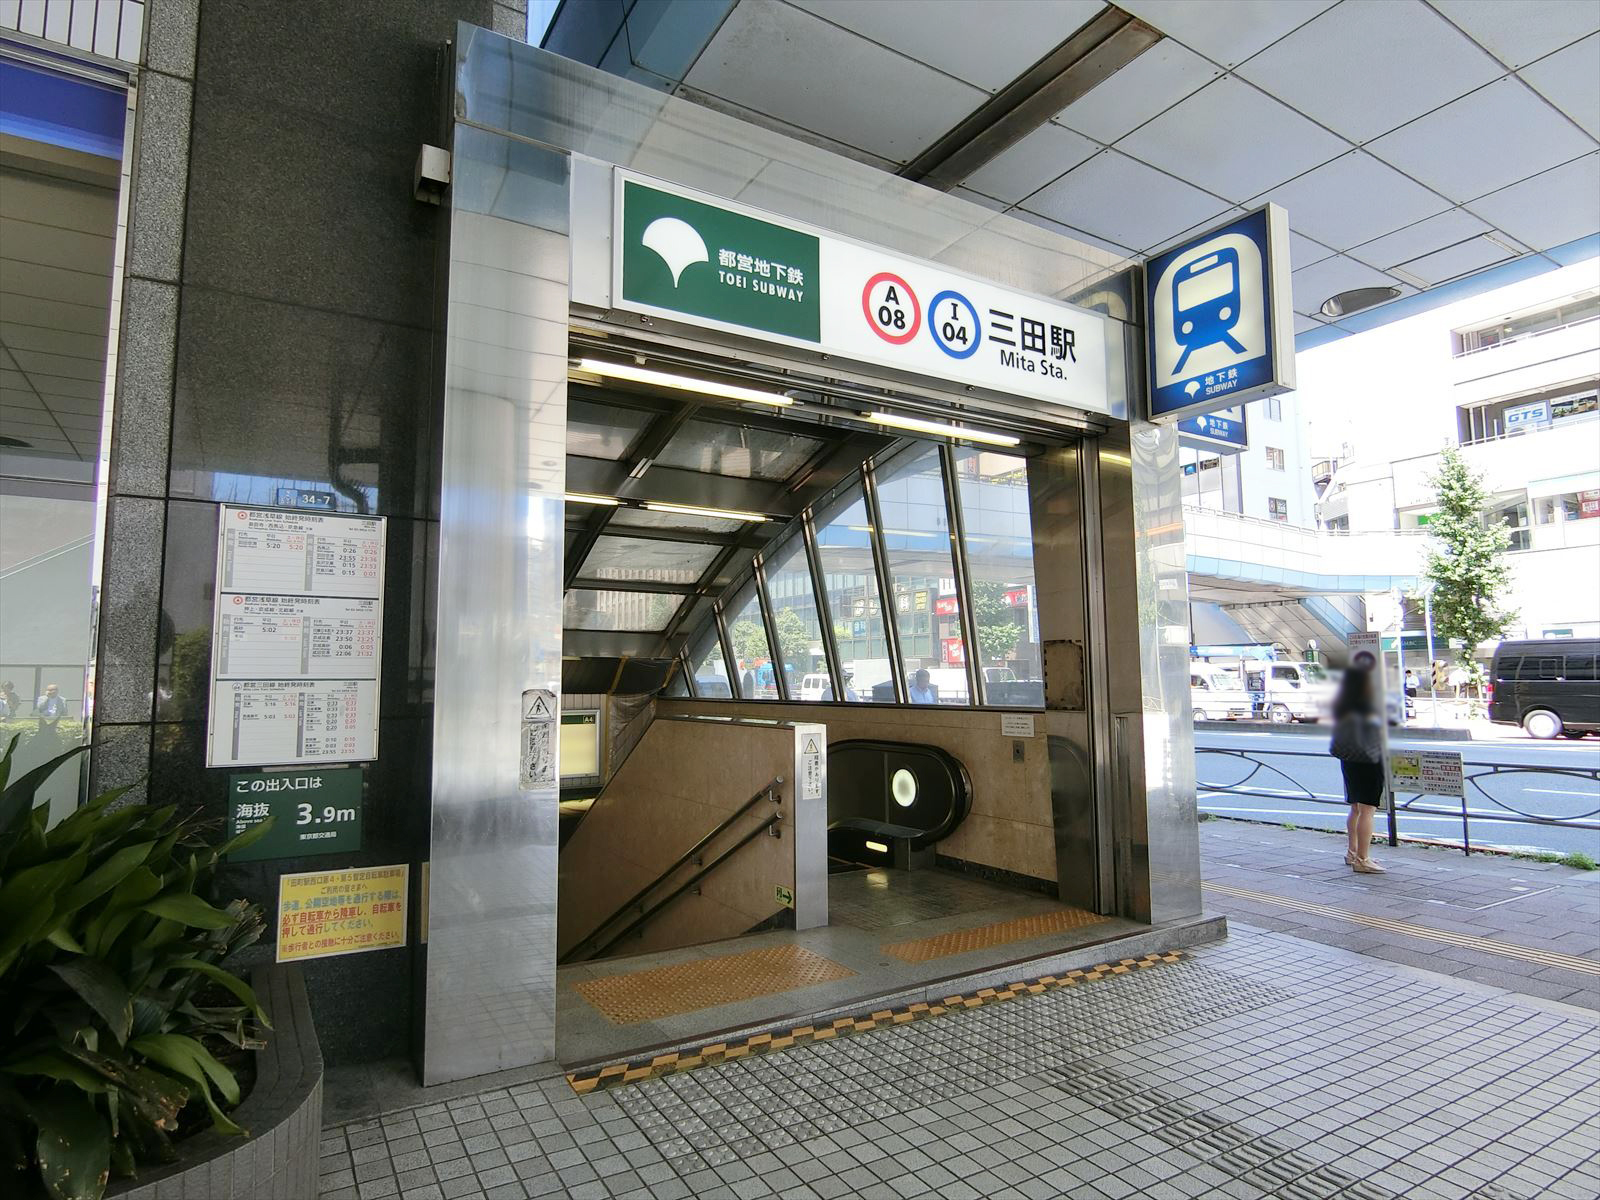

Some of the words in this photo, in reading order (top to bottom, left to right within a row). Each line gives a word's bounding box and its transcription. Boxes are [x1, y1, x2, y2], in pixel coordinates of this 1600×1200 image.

[719, 249, 804, 286] 都営地下鉄
[719, 272, 747, 292] TOEI
[752, 279, 803, 303] SUBWAY
[884, 285, 900, 305] A
[878, 307, 906, 331] 08
[951, 302, 958, 320] I
[942, 322, 968, 346] 04
[988, 307, 1076, 363] 三田駅
[1000, 349, 1035, 375] Mita
[1040, 357, 1068, 381] Sta.
[1205, 368, 1237, 385] 地下鉄
[1205, 379, 1238, 395] SUBWAY
[1210, 418, 1228, 430] 地下鉄
[1508, 408, 1543, 423] GTS
[1210, 428, 1228, 437] SUBWAY
[302, 495, 331, 504] 34-7
[237, 777, 322, 793] この出入口は
[236, 803, 270, 818] 海抜
[296, 803, 355, 825] 3.9m
[300, 832, 337, 840] 東京都交通局
